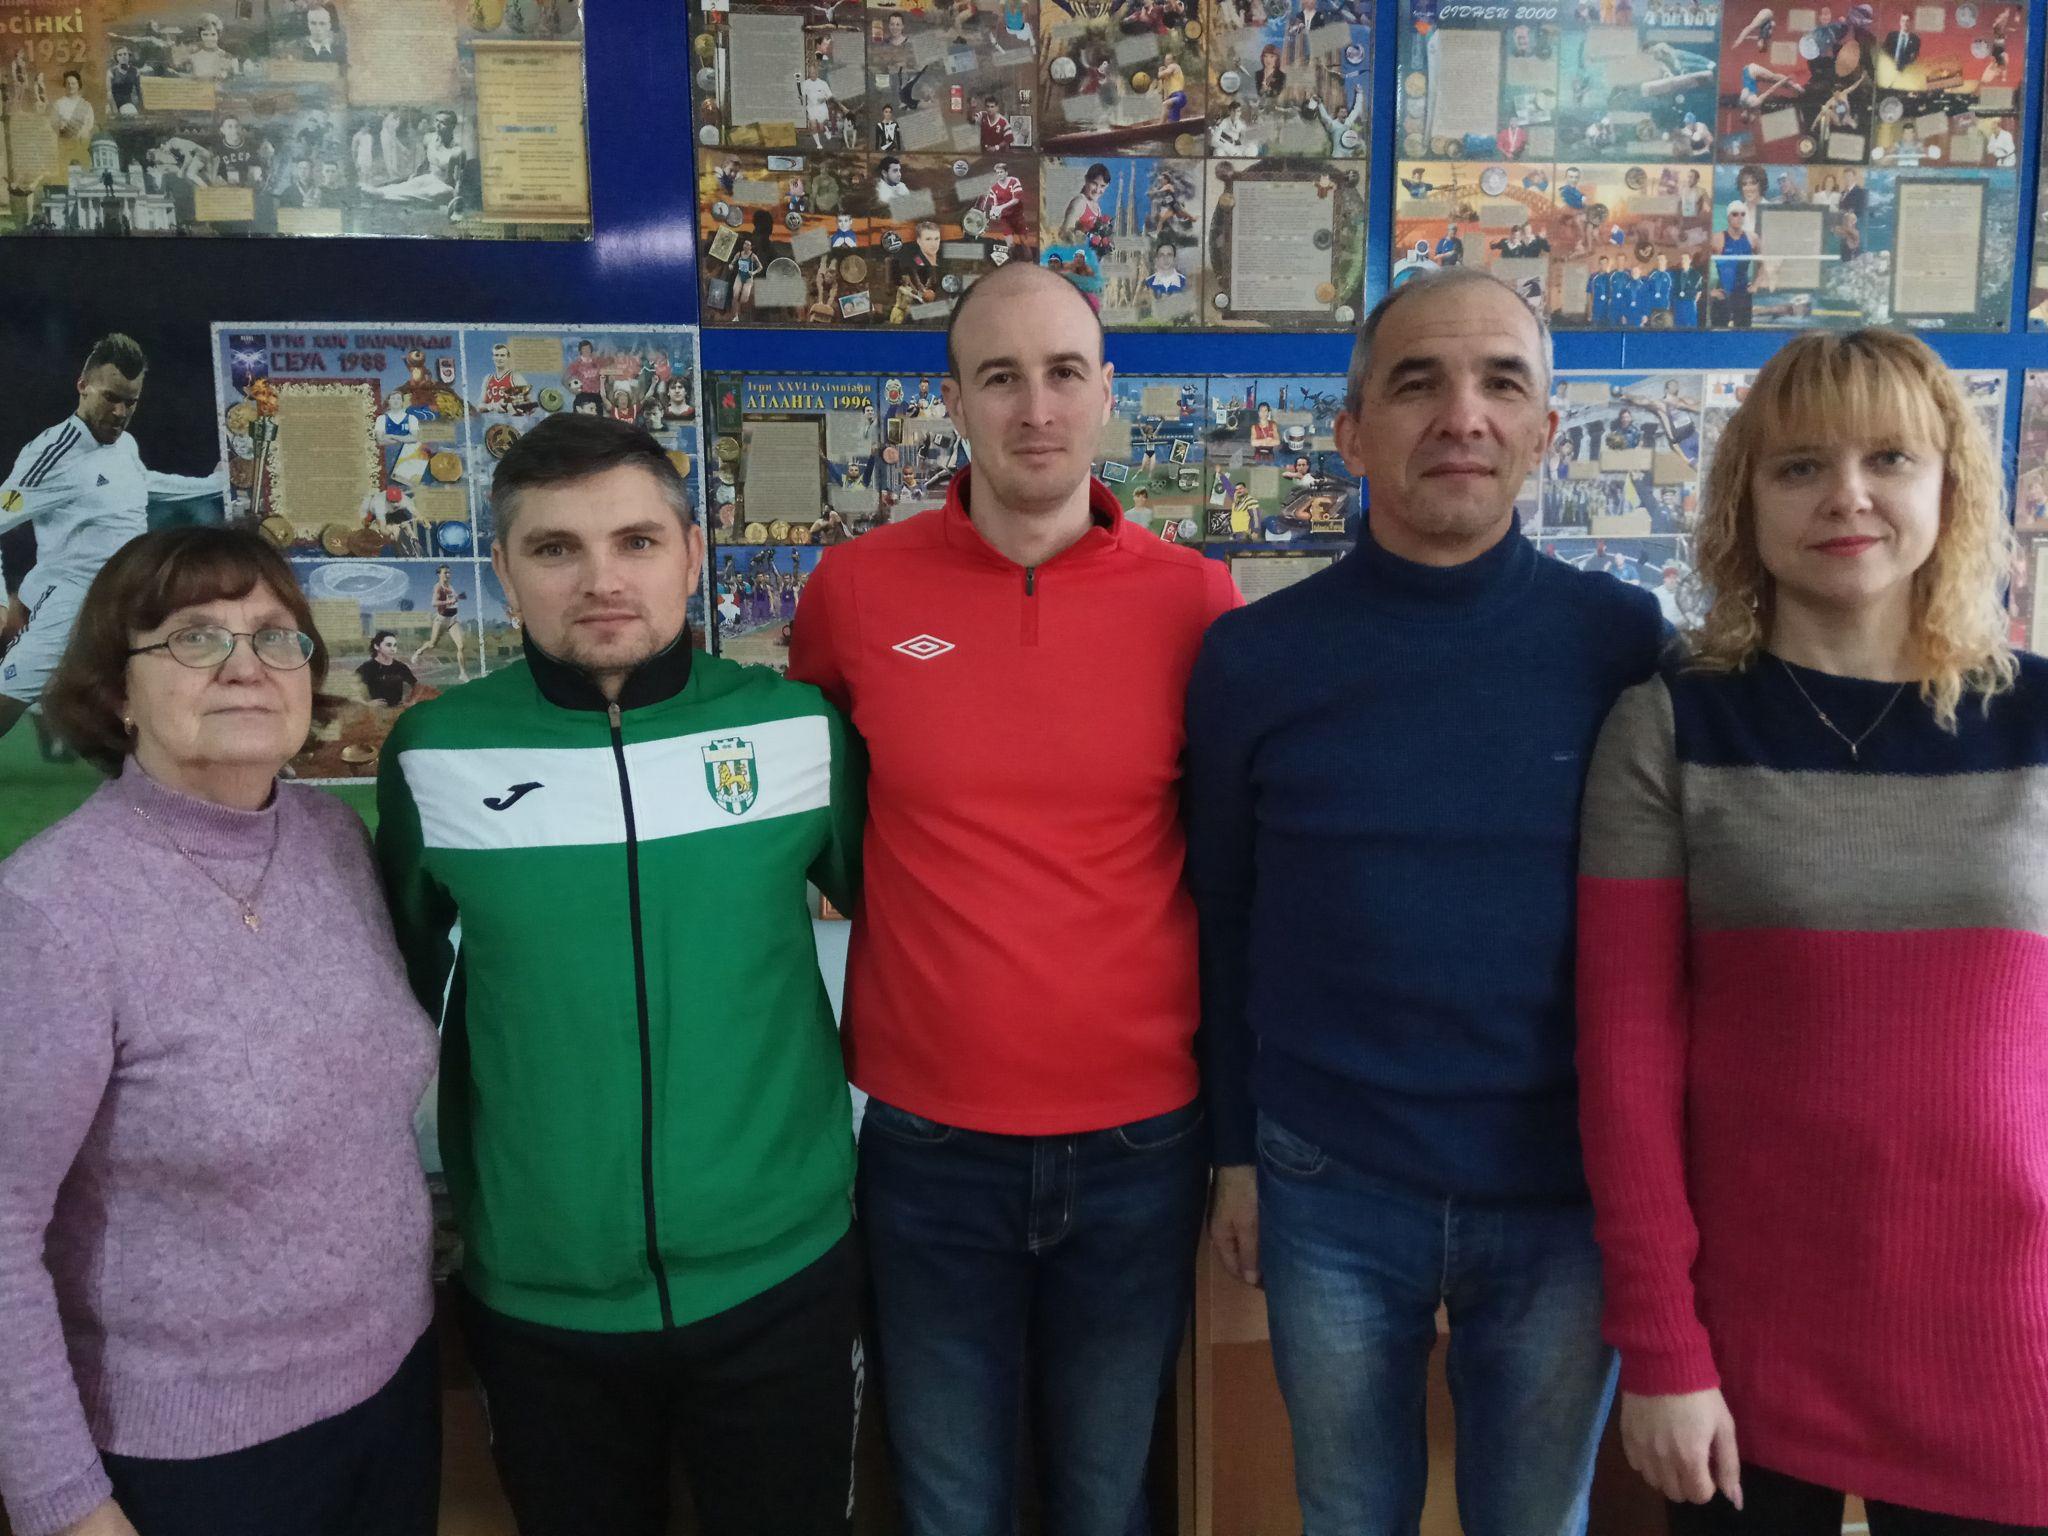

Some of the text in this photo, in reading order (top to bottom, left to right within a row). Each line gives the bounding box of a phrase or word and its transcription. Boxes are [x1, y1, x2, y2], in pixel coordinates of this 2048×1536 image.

[1514, 6, 1558, 20] 2000
[24, 38, 87, 64] 1952
[338, 353, 388, 373] 1988
[833, 396, 871, 409] 1996
